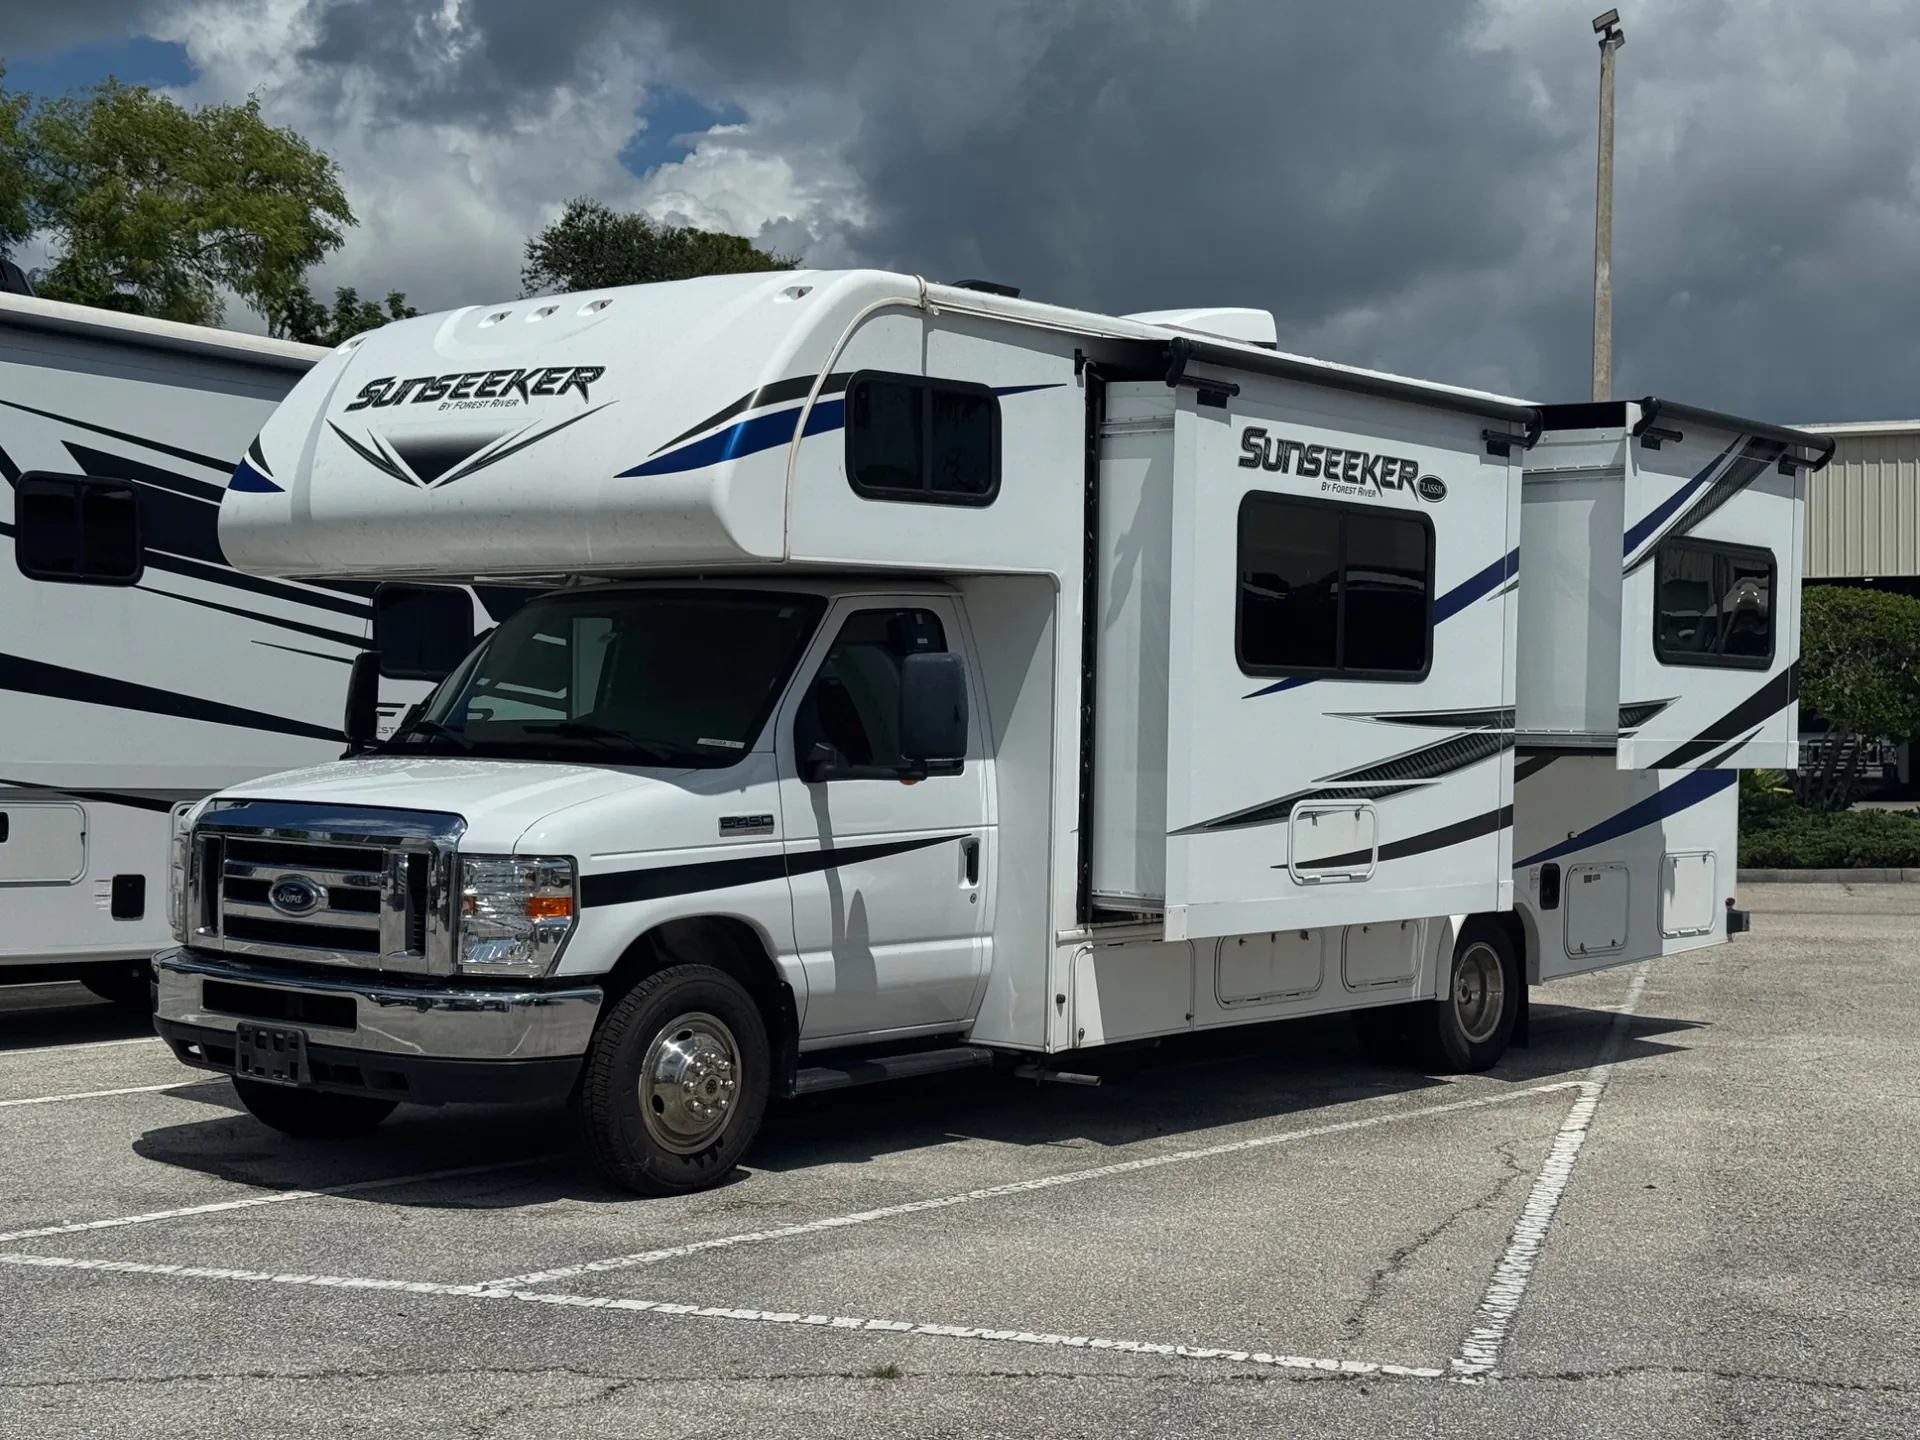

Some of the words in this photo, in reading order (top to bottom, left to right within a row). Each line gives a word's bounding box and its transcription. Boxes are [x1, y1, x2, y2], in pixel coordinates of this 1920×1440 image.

[343, 366, 606, 412] SUNSEEKER
[438, 402, 453, 411] BY
[453, 400, 490, 410] FOREST
[490, 398, 519, 408] RIVER
[1332, 483, 1357, 494] FOREST
[1357, 486, 1377, 498] RIVER
[1419, 481, 1445, 495] CLASSIC
[278, 888, 304, 904] Ford
